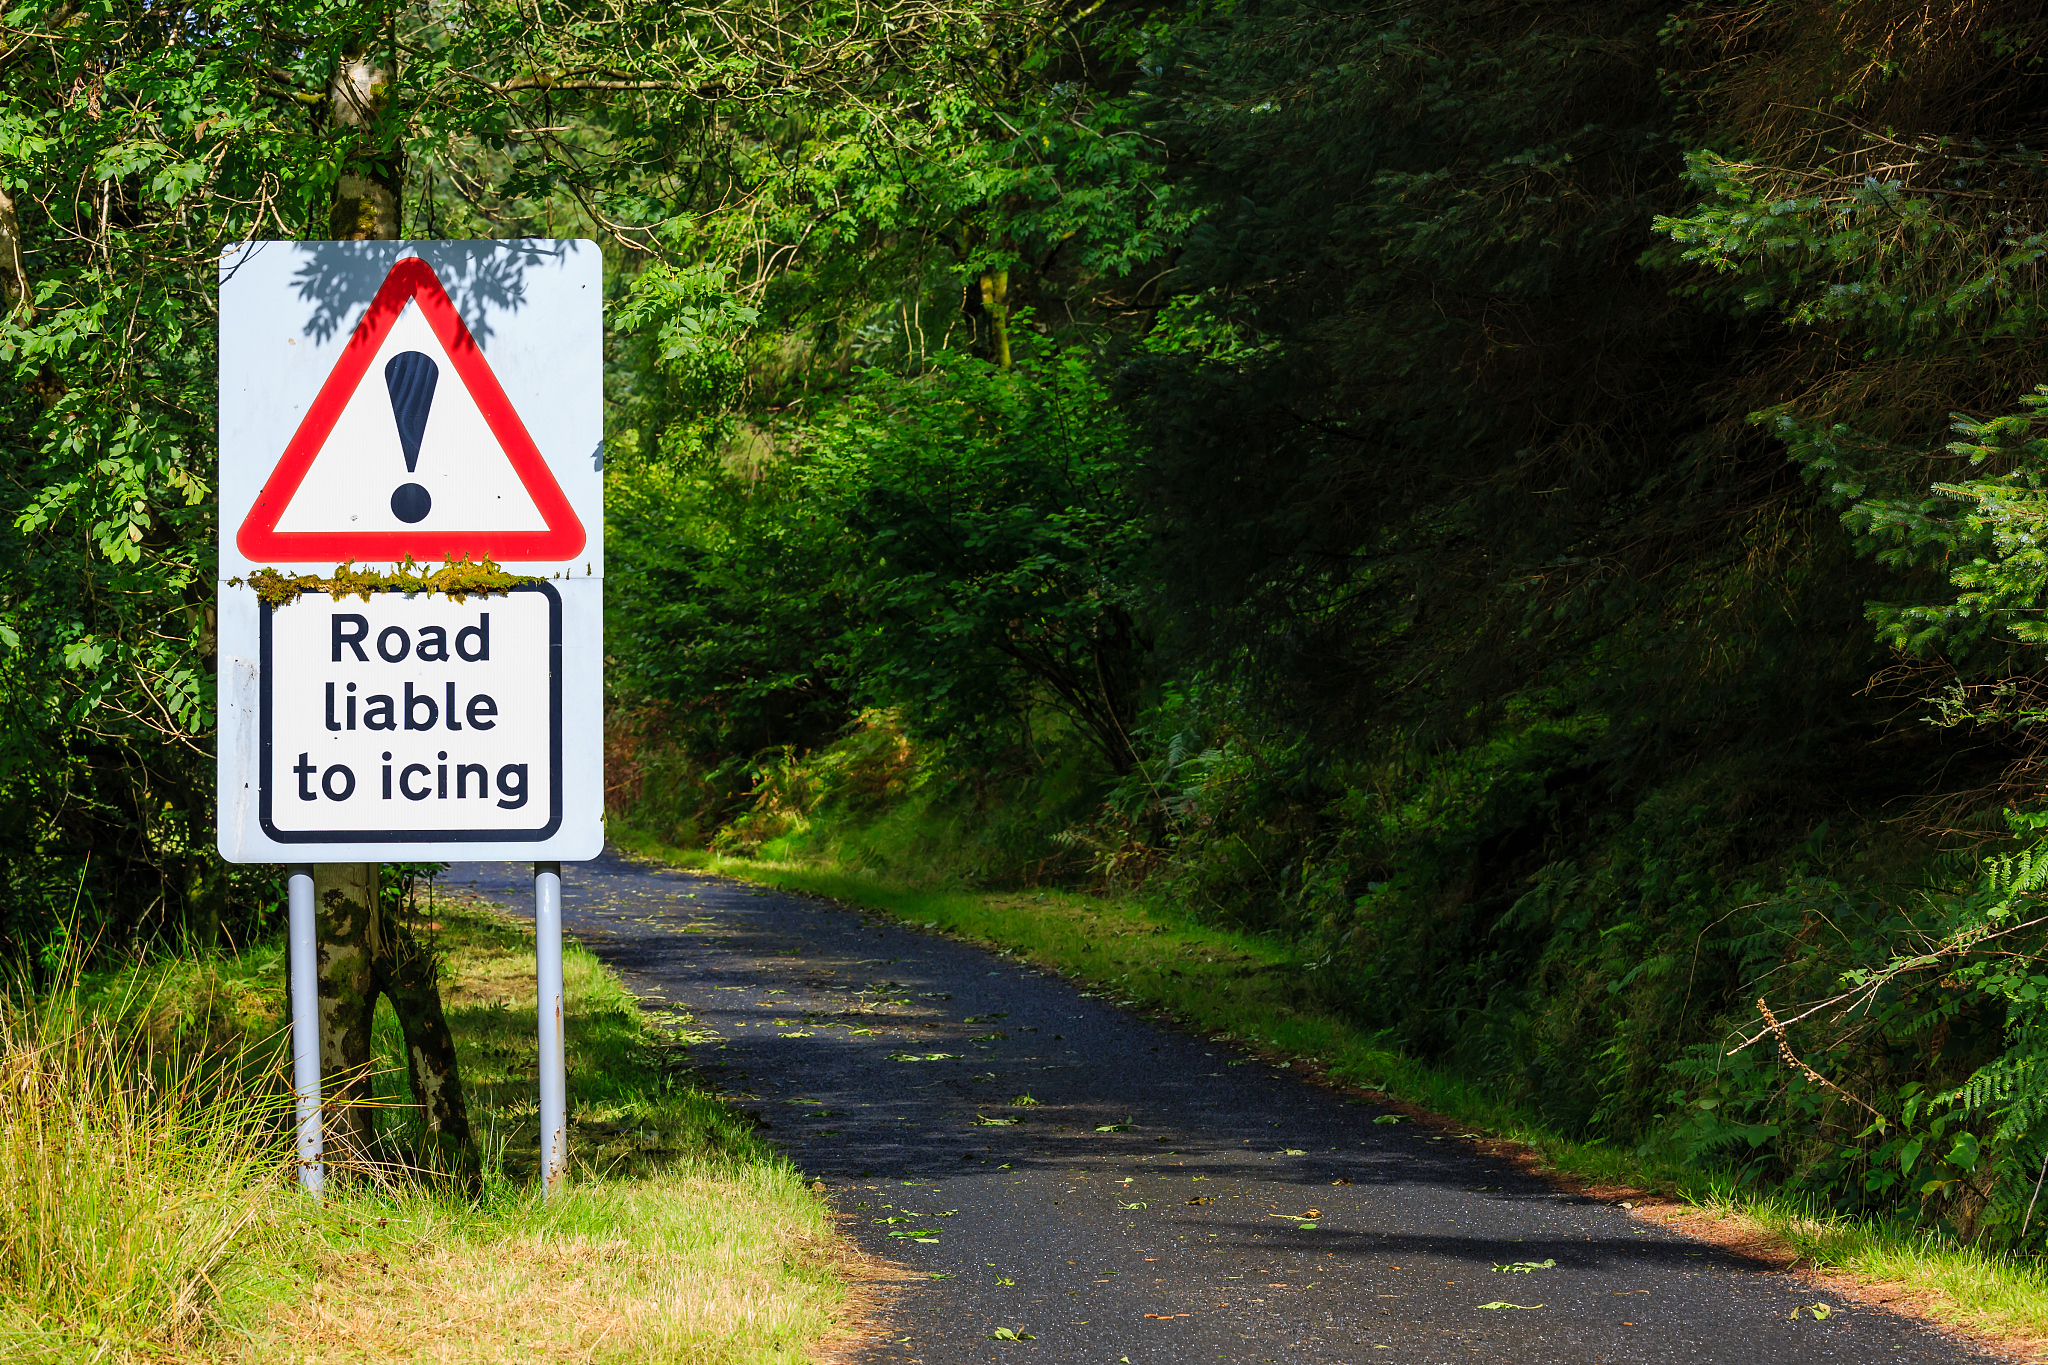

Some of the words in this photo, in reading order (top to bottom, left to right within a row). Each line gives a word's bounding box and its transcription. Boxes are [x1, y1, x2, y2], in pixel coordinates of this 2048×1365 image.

[331, 613, 490, 663] Road
[325, 682, 499, 732] liable
[293, 752, 356, 802] to
[381, 751, 529, 810] icing
